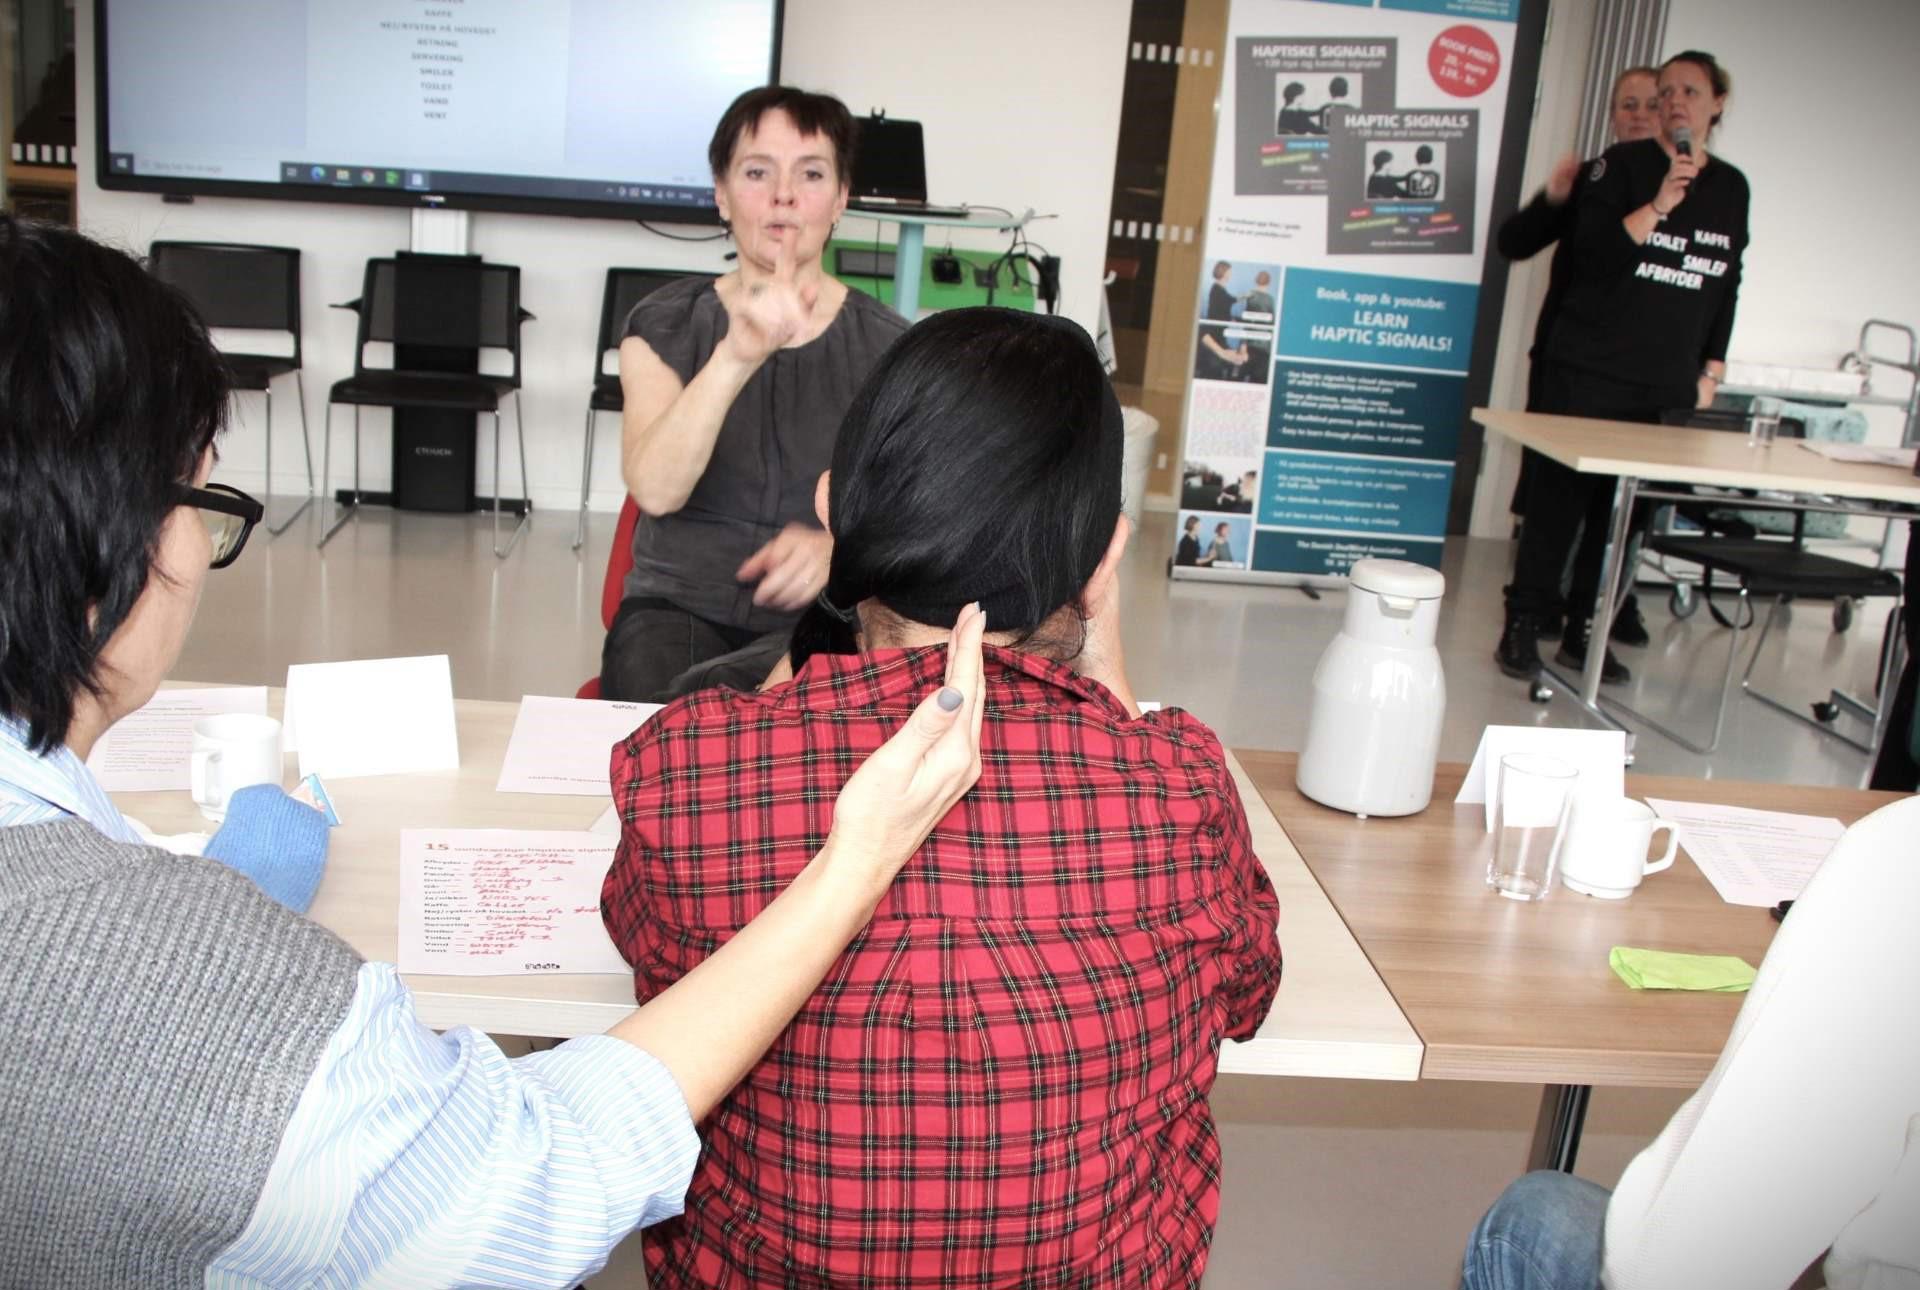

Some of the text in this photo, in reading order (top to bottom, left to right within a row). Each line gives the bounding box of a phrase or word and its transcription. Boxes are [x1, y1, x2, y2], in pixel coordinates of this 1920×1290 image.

[417, 37, 458, 48] RETNING
[411, 52, 464, 63] SERVERING
[1252, 44, 1387, 59] HAPTISKE SIGNALER
[1347, 59, 1383, 71] signaler
[423, 96, 449, 105] VAND
[1344, 114, 1469, 129] HAPTIC SIGNALS
[1646, 228, 1732, 252] TOILET KAFFE
[1635, 261, 1704, 290] AFBRYDER
[1316, 287, 1447, 310] Book, app & youtube:
[1353, 310, 1409, 329] LEARN
[1311, 325, 1453, 352] HAPTIC SIGNALS!
